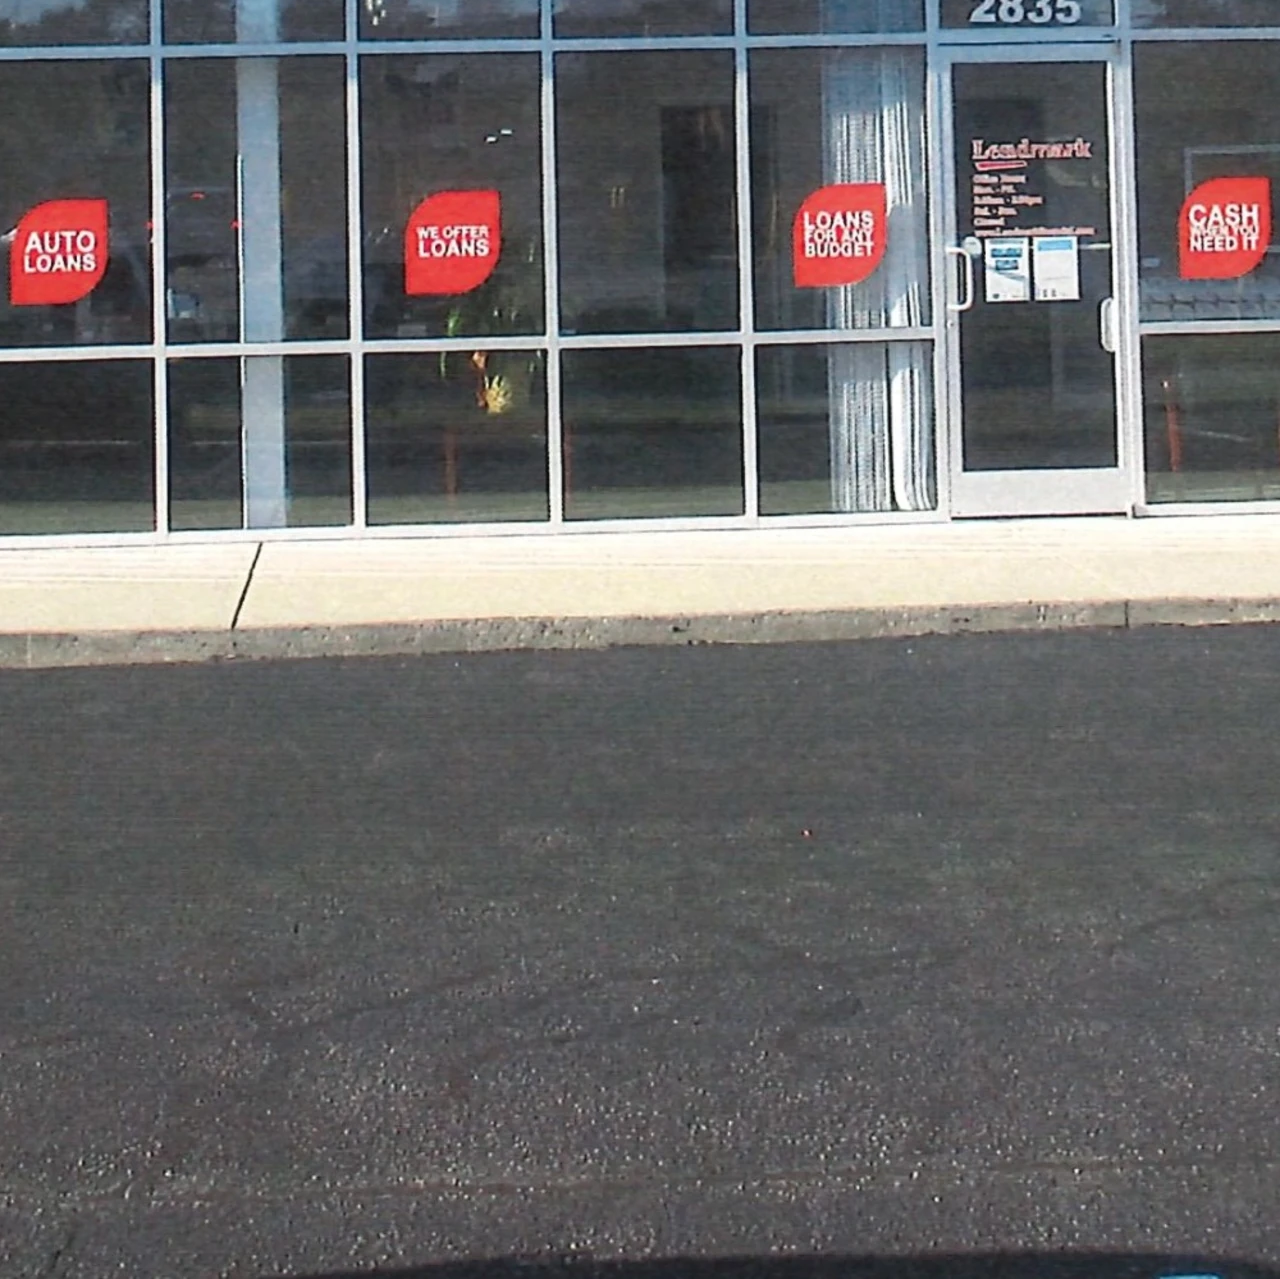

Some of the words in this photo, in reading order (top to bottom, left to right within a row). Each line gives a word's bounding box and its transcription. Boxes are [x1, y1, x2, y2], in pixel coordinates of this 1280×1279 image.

[972, 138, 1092, 160] Lendmark
[804, 211, 874, 229] LOANS
[1189, 204, 1259, 227] CASH
[416, 226, 439, 239] WE
[442, 225, 489, 238] OFFER
[804, 229, 837, 243] FOR
[842, 228, 874, 242] ANY
[25, 230, 95, 253] AUTO
[418, 238, 489, 257] LOANS
[805, 242, 874, 257] BUDGET
[1190, 236, 1238, 251] NEED
[1242, 236, 1259, 251] IT
[24, 253, 96, 273] LOANS
